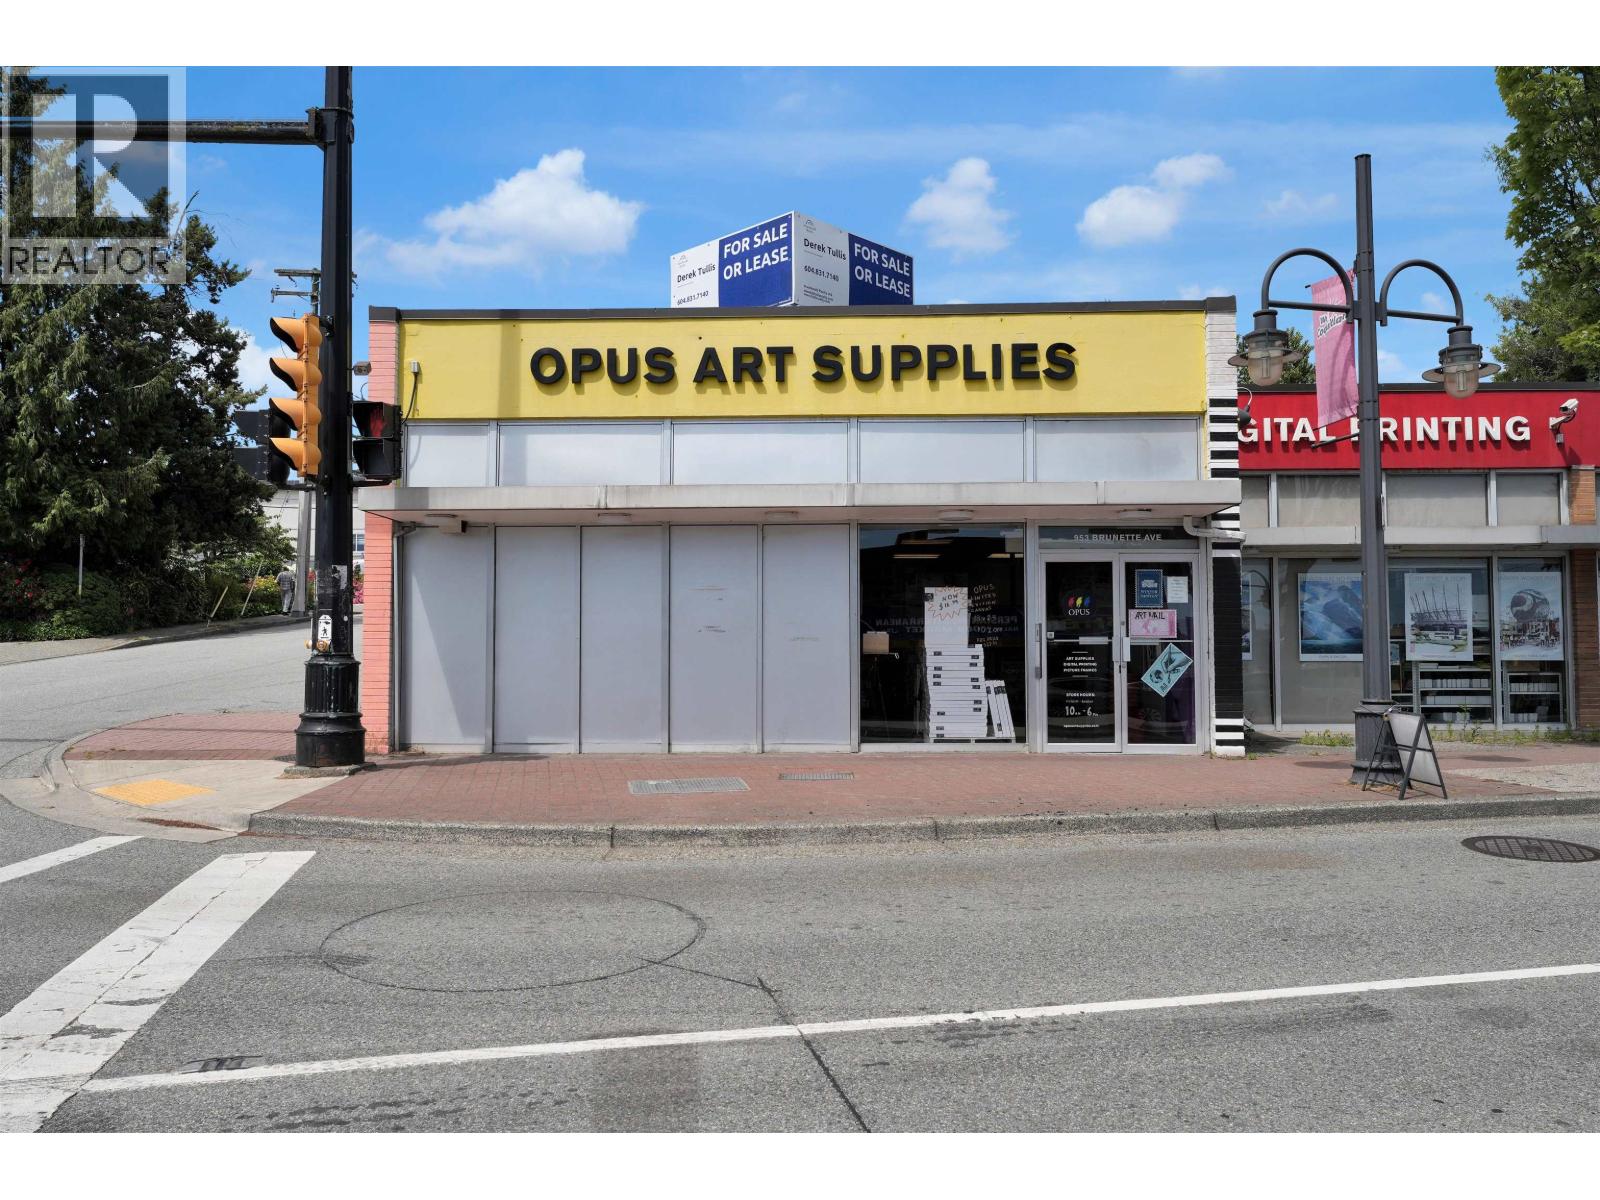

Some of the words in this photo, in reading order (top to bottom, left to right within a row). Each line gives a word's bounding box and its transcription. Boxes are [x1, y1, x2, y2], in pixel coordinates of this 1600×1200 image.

[724, 237, 750, 259] FOR
[753, 223, 788, 248] SALE
[803, 238, 826, 253] Derek
[827, 246, 847, 261] Tullis
[723, 262, 742, 280] OR
[745, 246, 789, 273] LEASE
[854, 243, 879, 265] FOR
[881, 253, 910, 277] SALE
[677, 269, 697, 283] Derek
[698, 263, 716, 275] Tullis
[854, 265, 873, 284] OR
[875, 272, 911, 298] LEASE
[530, 346, 676, 385] OPUS
[693, 345, 795, 383] ART
[811, 342, 1077, 382] SUPPLIES
[1092, 533, 1141, 541] BRUNETTE
[1143, 533, 1162, 541] AVE
[973, 583, 995, 594] OPUS
[1068, 608, 1091, 616] OPUS
[1135, 611, 1147, 620] ART
